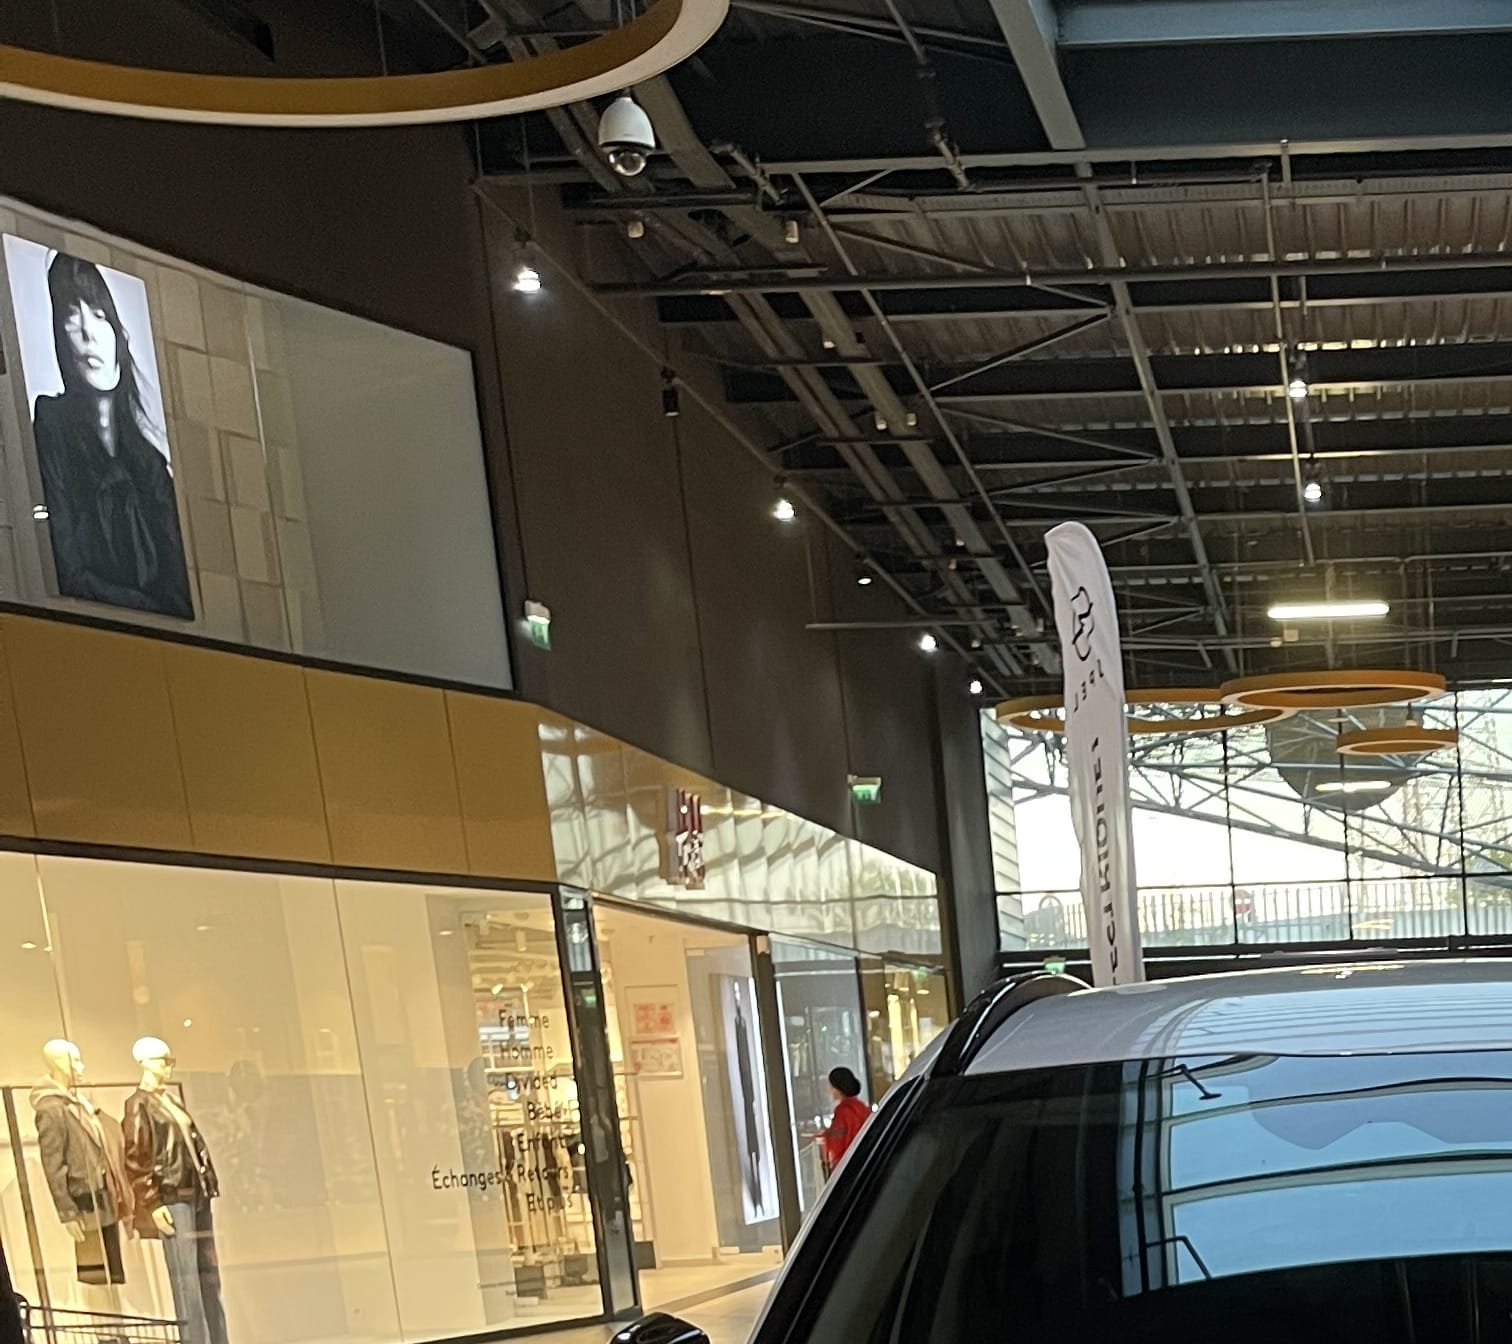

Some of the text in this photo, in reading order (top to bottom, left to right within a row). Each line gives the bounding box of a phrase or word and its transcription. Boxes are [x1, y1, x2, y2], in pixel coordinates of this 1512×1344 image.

[498, 1009, 550, 1030] Femme
[501, 1044, 554, 1062] Homme
[506, 1073, 558, 1092] Divided
[517, 1131, 567, 1151] Enfnt
[432, 1164, 501, 1191] Échanges
[517, 1164, 569, 1184] Retors
[547, 1195, 573, 1214] pus
